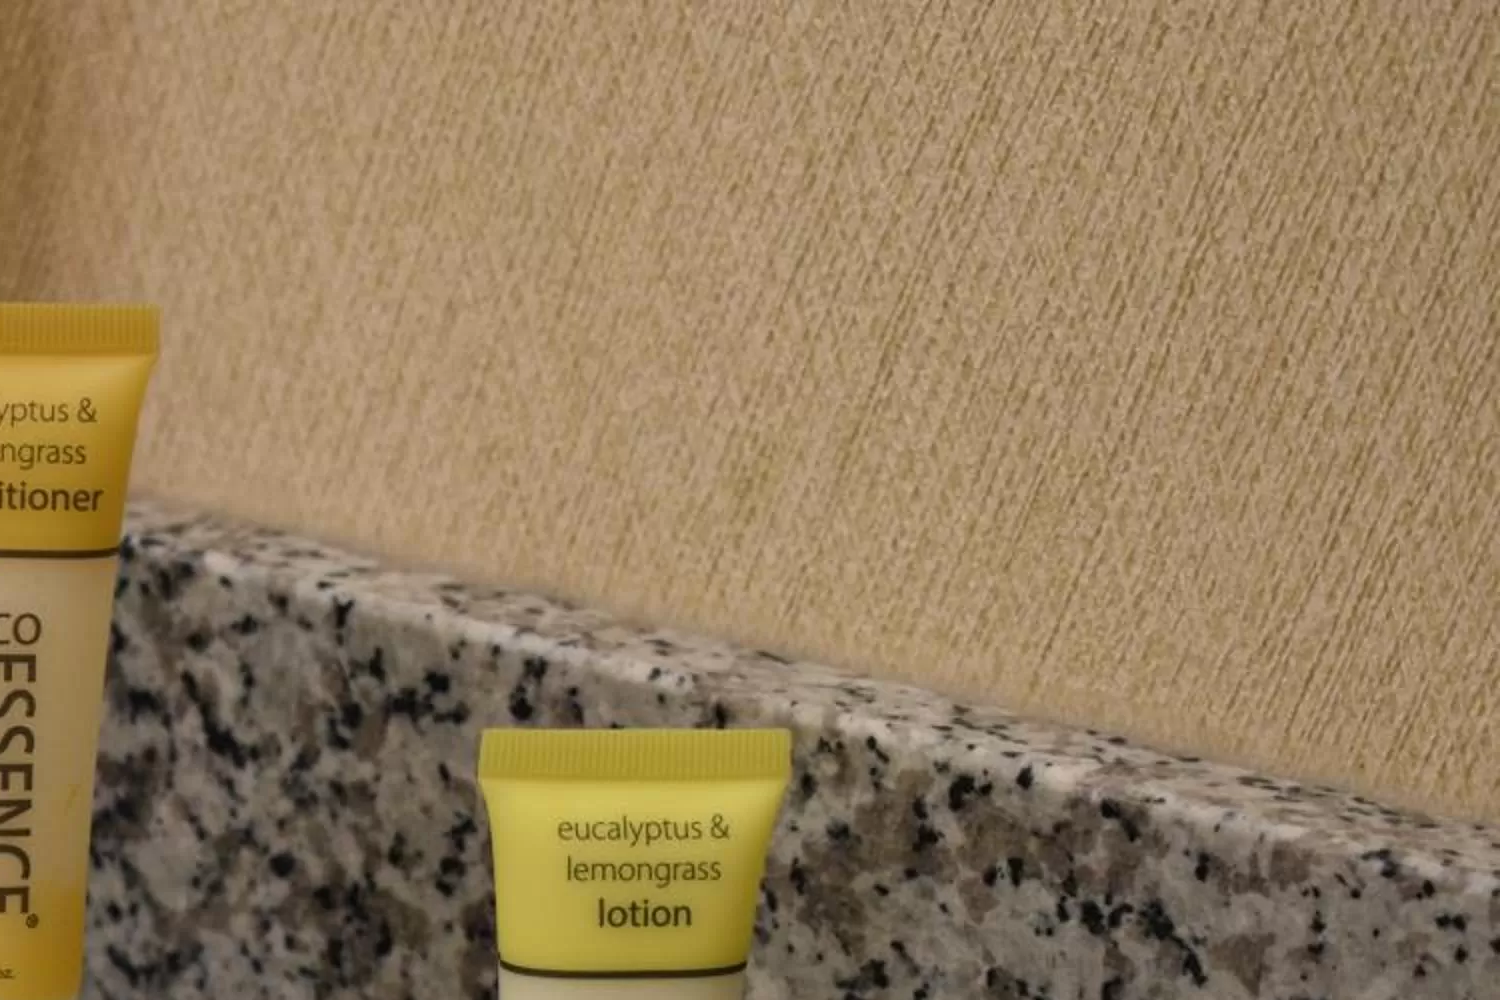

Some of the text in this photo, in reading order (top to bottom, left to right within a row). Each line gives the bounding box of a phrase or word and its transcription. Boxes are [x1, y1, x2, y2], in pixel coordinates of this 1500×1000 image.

[76, 397, 98, 423] &
[557, 814, 731, 846] eucalyptus &
[567, 855, 722, 888] lemongrass
[598, 897, 693, 928] lotion
